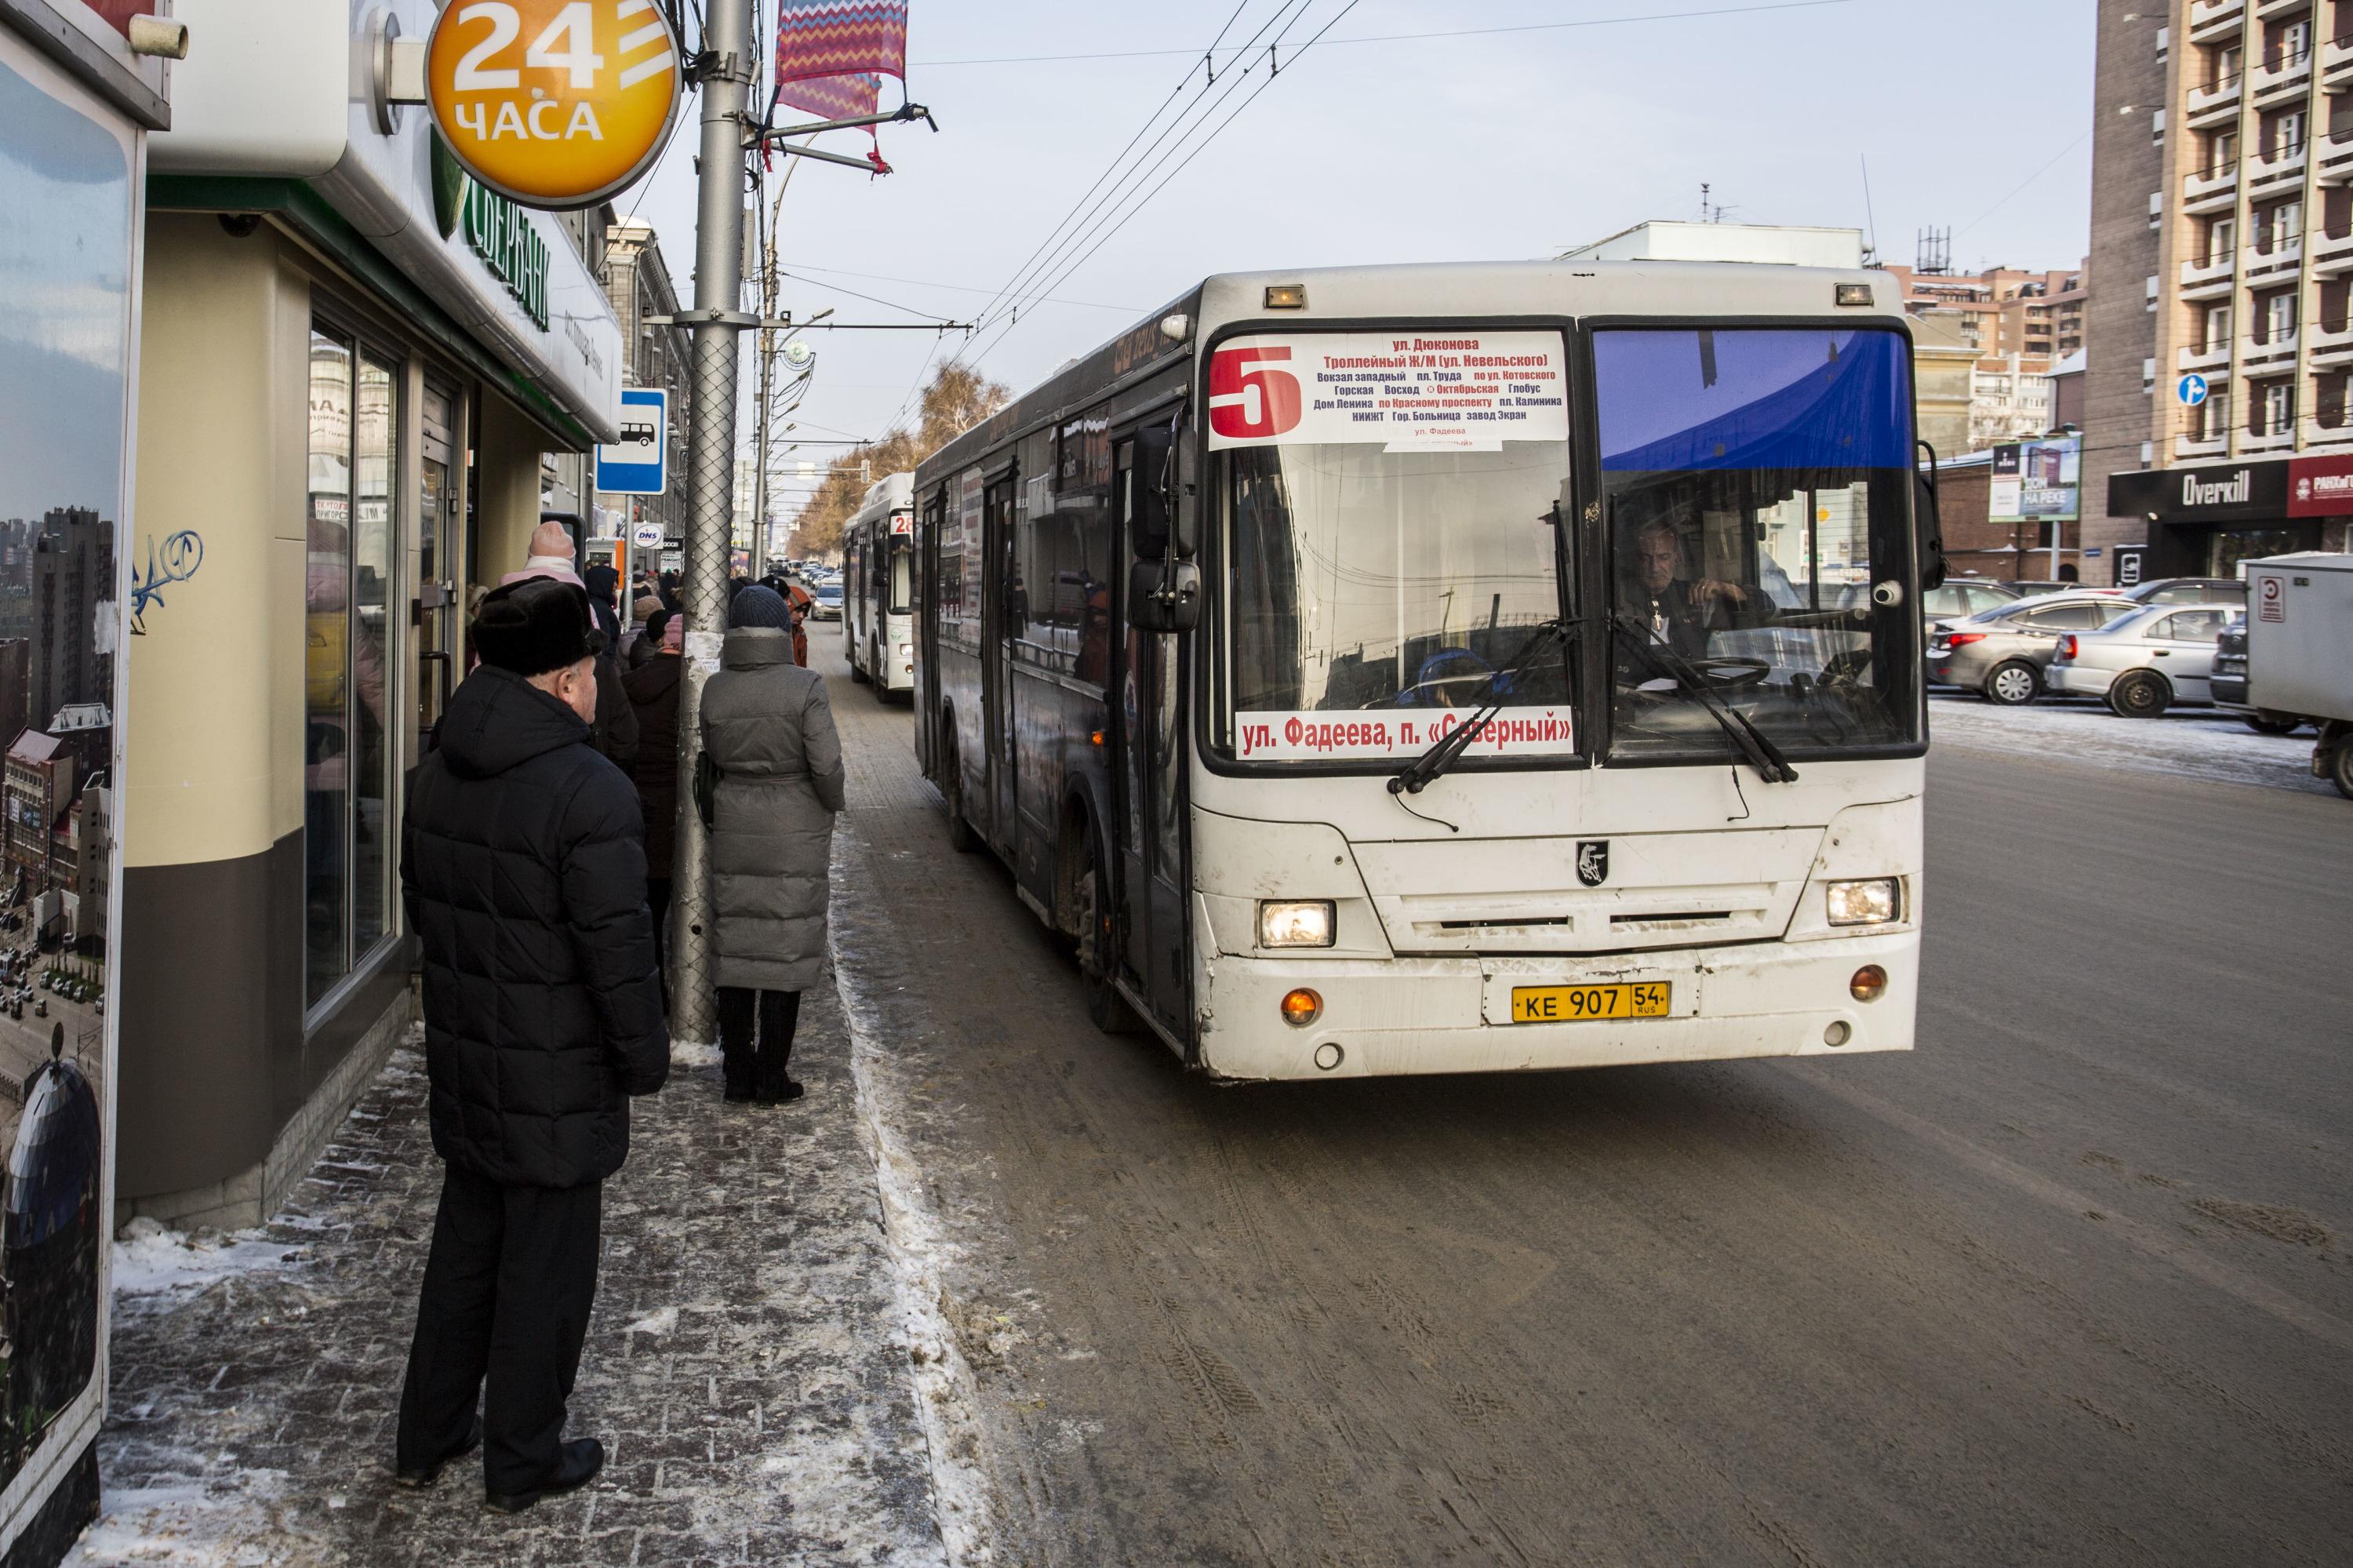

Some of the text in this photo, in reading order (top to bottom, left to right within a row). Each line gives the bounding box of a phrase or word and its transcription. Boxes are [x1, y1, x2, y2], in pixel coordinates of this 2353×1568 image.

[454, 1, 604, 92] 24
[455, 100, 604, 141] ЧАСА
[1393, 339, 1479, 352] ул. Дюконова
[1324, 354, 1547, 369] Троллейный Ж/М (ул. Невельского)
[1317, 370, 1555, 383] Вокзал западный пл. Труда по ул. Котовского
[1209, 346, 1301, 438] 5
[1334, 384, 1541, 396] Горская Восход Октябрьская Глобус
[1313, 396, 1562, 411] Дом Ленина по Красному проспекту пл. Калинина
[1352, 410, 1527, 422] НИИЖТ Гор. Больница завод Экран
[2183, 470, 2250, 505] Overkill
[2040, 490, 2066, 504] РЕКЕ
[1242, 724, 1277, 755] ул.
[1285, 717, 1393, 753] Фадеева,
[1401, 722, 1420, 744] п.
[1569, 989, 1618, 1016] 907
[1635, 986, 1659, 1006] 54
[1638, 1006, 1656, 1014] RUS
